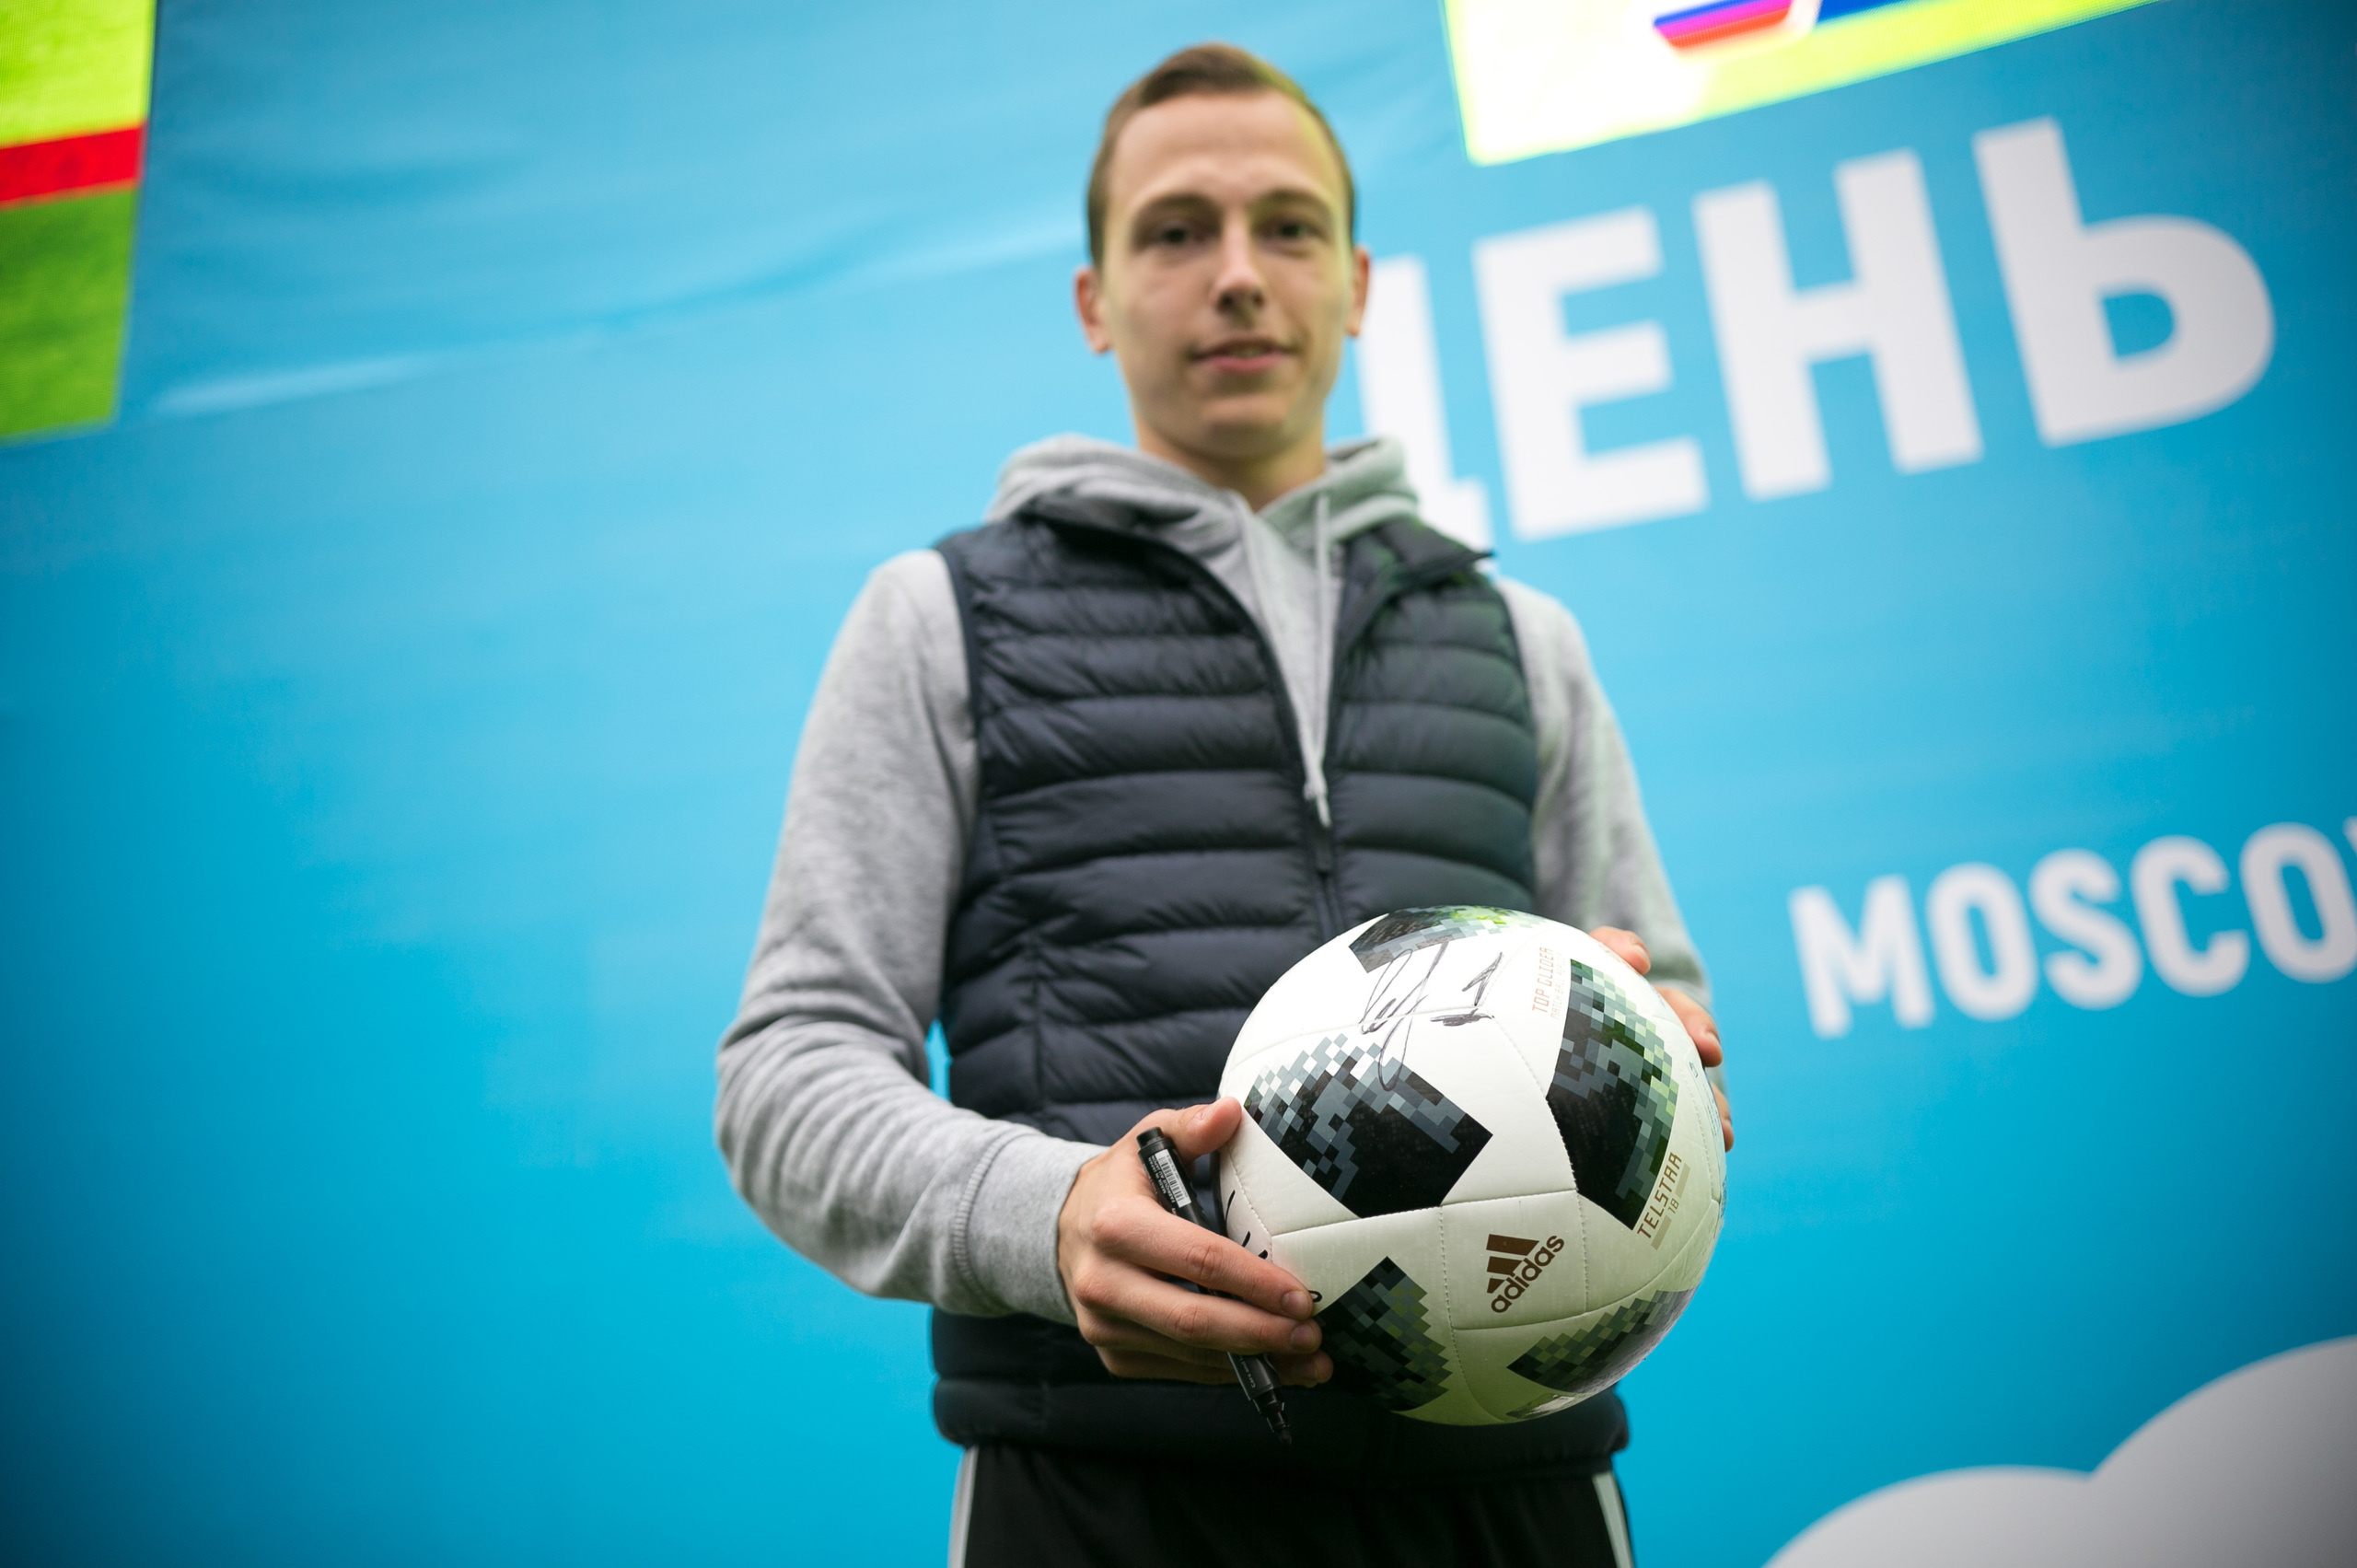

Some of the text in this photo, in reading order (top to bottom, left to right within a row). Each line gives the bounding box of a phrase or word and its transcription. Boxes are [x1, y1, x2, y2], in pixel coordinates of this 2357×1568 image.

[1788, 817, 2357, 1039] MOSCO
[1531, 947, 1554, 1013] TOP GLIDER
[1637, 1152, 1682, 1238] TELSTAR
[1667, 1198, 1679, 1214] 18
[1491, 1236, 1565, 1313] adidas
